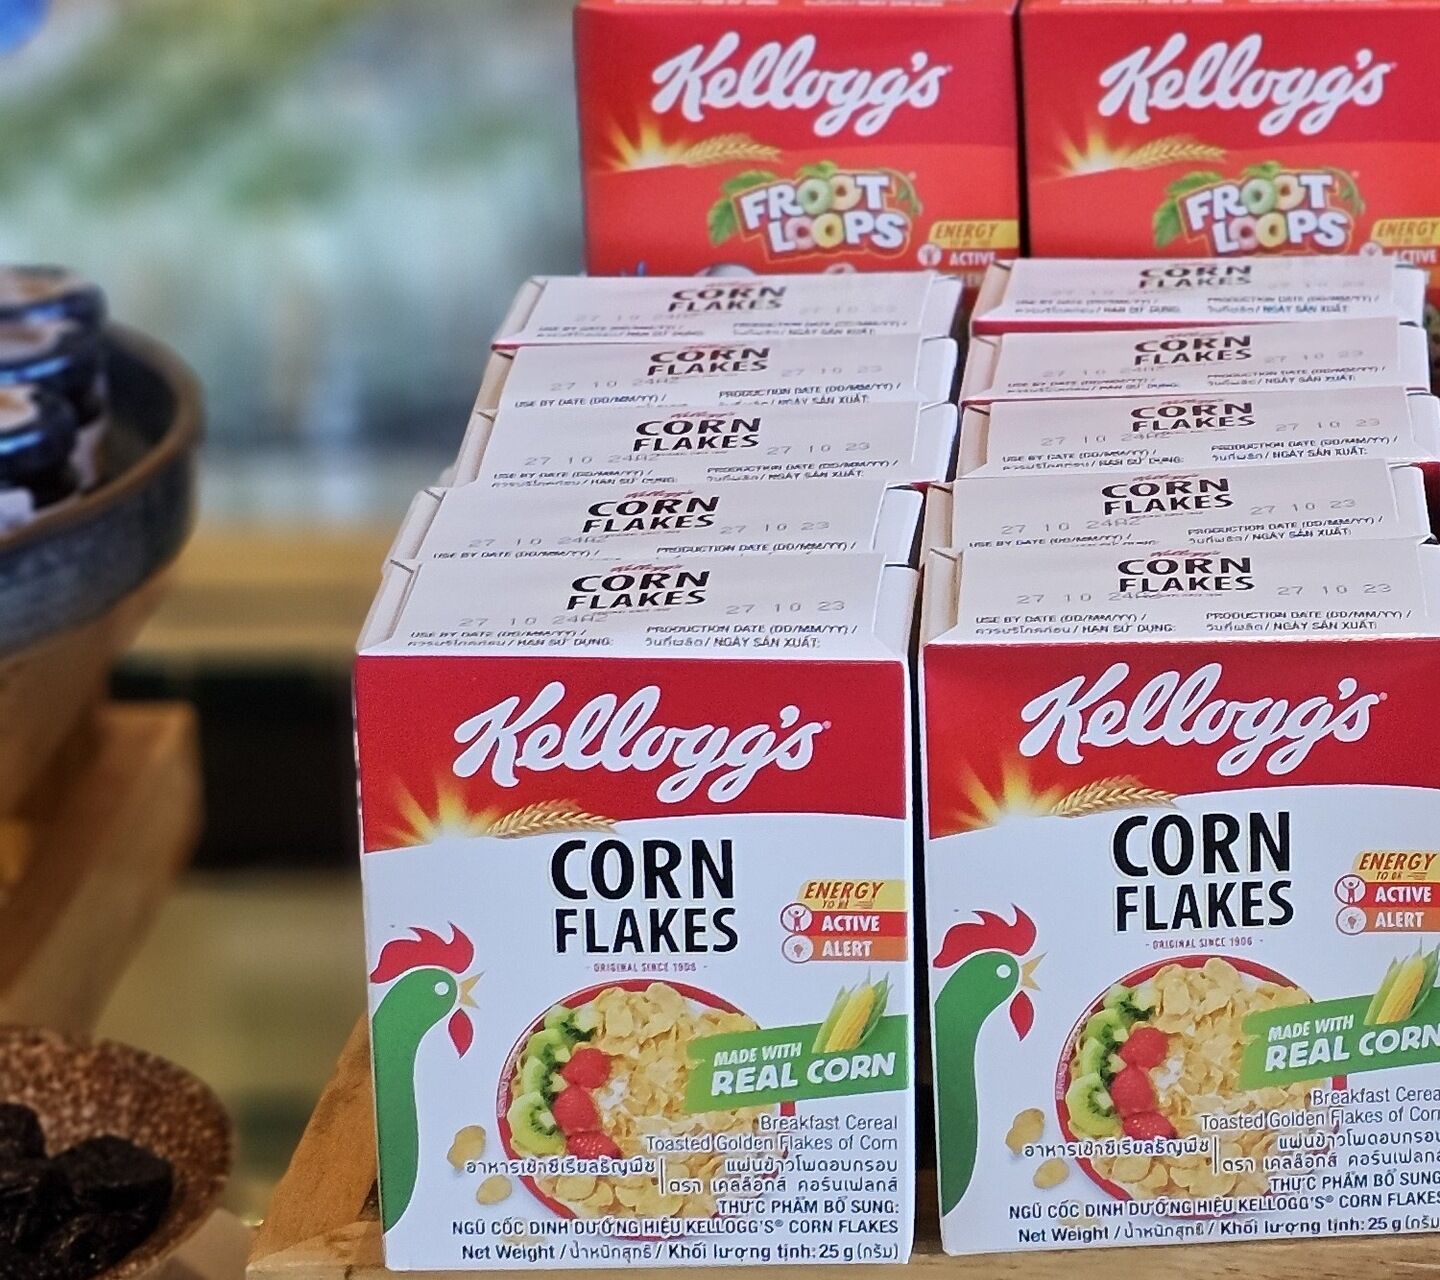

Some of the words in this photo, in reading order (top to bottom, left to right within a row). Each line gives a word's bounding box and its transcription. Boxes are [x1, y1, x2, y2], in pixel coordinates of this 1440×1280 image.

[652, 32, 943, 136] Kellogg's
[1099, 32, 1387, 135] Kellogg's
[741, 175, 889, 229] FROOT
[1186, 175, 1332, 230] FROOT
[768, 211, 905, 253] LOOPS
[935, 223, 998, 239] ENERGY
[1212, 210, 1348, 253] LOOPS
[1377, 221, 1439, 238] ENERGY
[1139, 265, 1251, 277] CORN
[1139, 276, 1252, 289] FLAKES
[672, 286, 786, 301] CORN
[668, 299, 782, 312] FLAKES
[1134, 336, 1251, 353] CORN
[650, 348, 770, 364] CORN
[1134, 349, 1253, 365] FLAKES
[647, 360, 769, 376] FLAKES
[1130, 402, 1253, 419] CORN
[636, 418, 761, 436] CORN
[1132, 416, 1256, 432] FLAKES
[633, 434, 760, 452] FLAKES
[1101, 478, 1229, 499] CORN
[587, 496, 720, 517] CORN
[1104, 494, 1234, 515] FLAKES
[581, 514, 715, 534] FLAKES
[1118, 558, 1251, 575] CORN
[572, 571, 710, 592] CORN
[1119, 576, 1255, 593] FLAKES
[1277, 586, 1304, 596] 27
[1322, 585, 1348, 595] 10
[1364, 584, 1392, 593] 23
[567, 590, 706, 610] FLAKES
[726, 604, 755, 614] 27
[775, 603, 801, 612] 10
[818, 601, 845, 611] 23
[1017, 594, 1044, 604] 27
[1064, 593, 1091, 602] 10
[1206, 611, 1287, 619] PRODUCTION
[647, 625, 730, 633] PRODUCTION
[1019, 662, 1380, 777] Kellogg's
[451, 680, 816, 804] Kellogg's
[1112, 811, 1291, 877] CORN
[550, 839, 734, 900] CORN
[1358, 853, 1438, 871] ENERGY
[804, 881, 885, 900] ENERGY
[1374, 886, 1432, 903] ACTIVE
[1116, 880, 1294, 932] FLAKES
[821, 914, 880, 932] ACTIVE
[1374, 911, 1424, 928] ALERT
[554, 907, 739, 953] FLAKES
[821, 940, 873, 957] ALERT
[1268, 1020, 1310, 1042] MADE
[1315, 1014, 1354, 1033] WITH
[714, 1047, 756, 1066] MADE
[761, 1042, 802, 1061] WITH
[1265, 1035, 1350, 1072] REAL
[711, 1062, 798, 1096] REAL
[807, 1052, 896, 1084] CORN
[1312, 1088, 1390, 1106] Breakfast
[760, 1115, 839, 1131] Breakfast
[846, 1114, 898, 1131] Cereal
[1201, 1113, 1264, 1130] Toasted
[1269, 1111, 1324, 1127] Golden
[1331, 1108, 1383, 1124] Flakes
[1388, 1107, 1404, 1121] of
[647, 1136, 712, 1151] Toasted
[716, 1135, 773, 1151] Golden
[780, 1135, 833, 1151] Flakes
[838, 1135, 854, 1150] of
[860, 1135, 898, 1150] Corn
[1085, 1202, 1124, 1217] DINH
[1339, 1193, 1383, 1208] CORN
[530, 1222, 569, 1235] DINH
[789, 1220, 833, 1233] CORN
[839, 1220, 899, 1233] FLAKES
[1018, 1228, 1046, 1243] Net
[1051, 1226, 1109, 1243] Weight
[1220, 1219, 1258, 1235] Khối
[1368, 1217, 1387, 1230] 25
[1391, 1219, 1400, 1231] g
[462, 1245, 491, 1260] Net
[495, 1245, 555, 1262] Weight
[668, 1242, 707, 1259] Khối
[819, 1244, 839, 1259] 25
[844, 1248, 853, 1261] g
